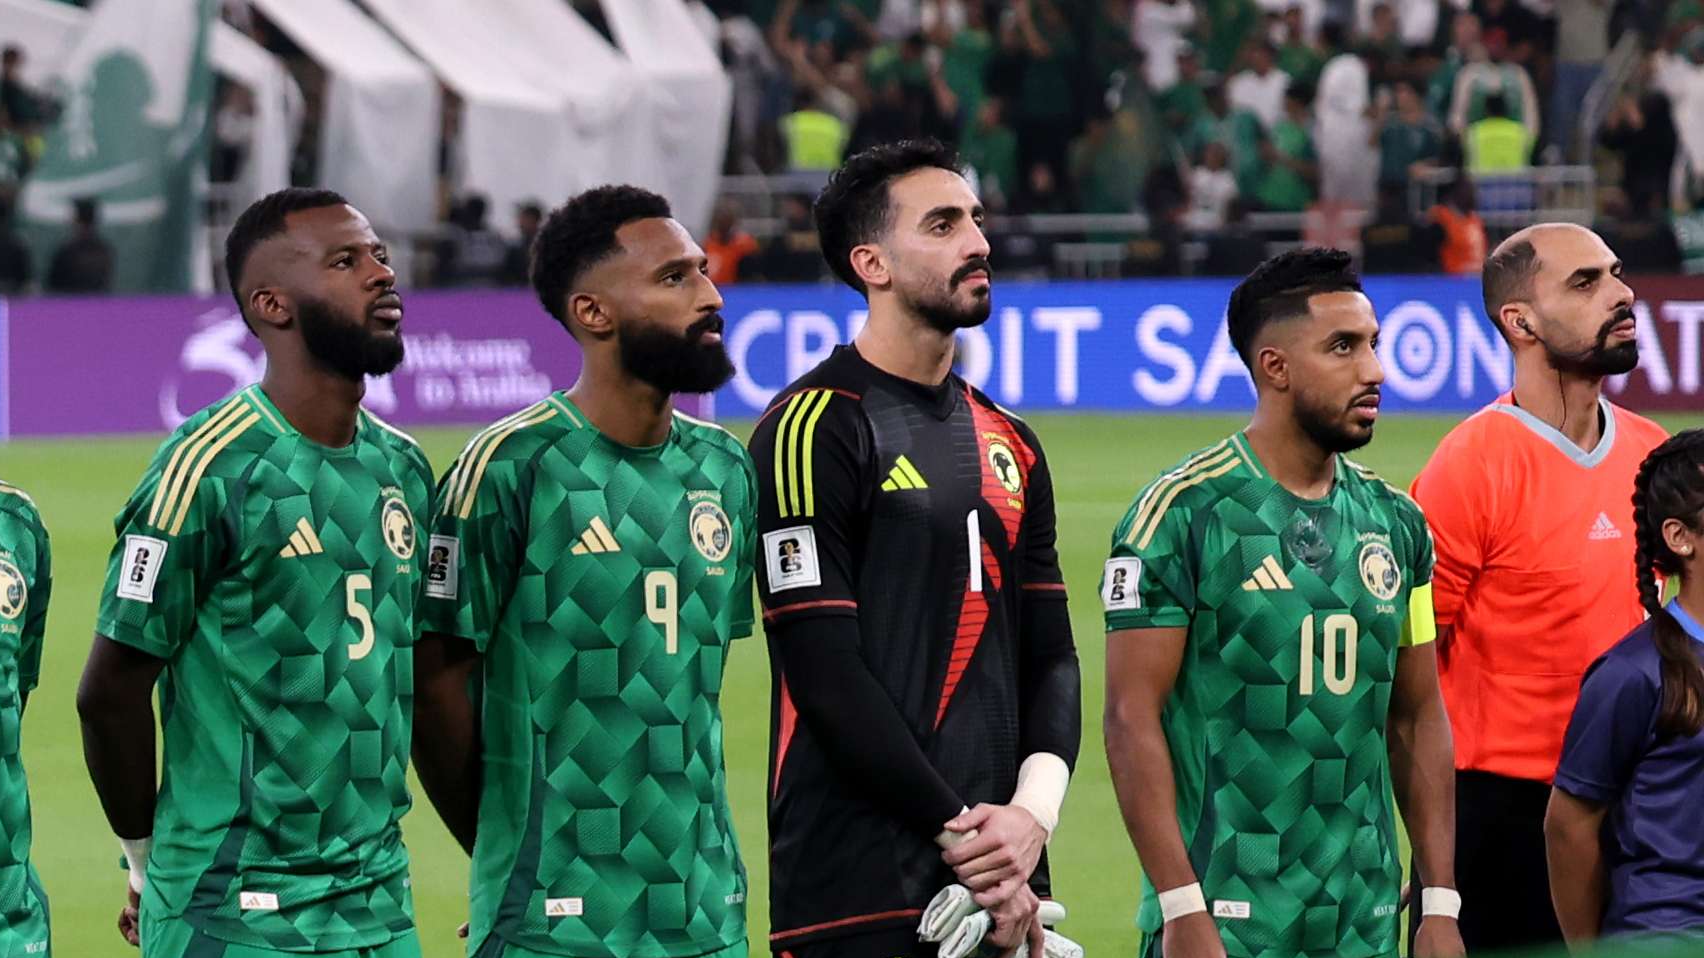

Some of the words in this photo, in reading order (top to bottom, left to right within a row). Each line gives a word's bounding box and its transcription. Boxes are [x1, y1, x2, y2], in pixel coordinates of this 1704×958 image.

[1133, 301, 1513, 404] SAON
[967, 508, 984, 593] 1
[346, 573, 375, 660] 5
[644, 570, 679, 655] 9
[1299, 613, 1358, 696] 10
